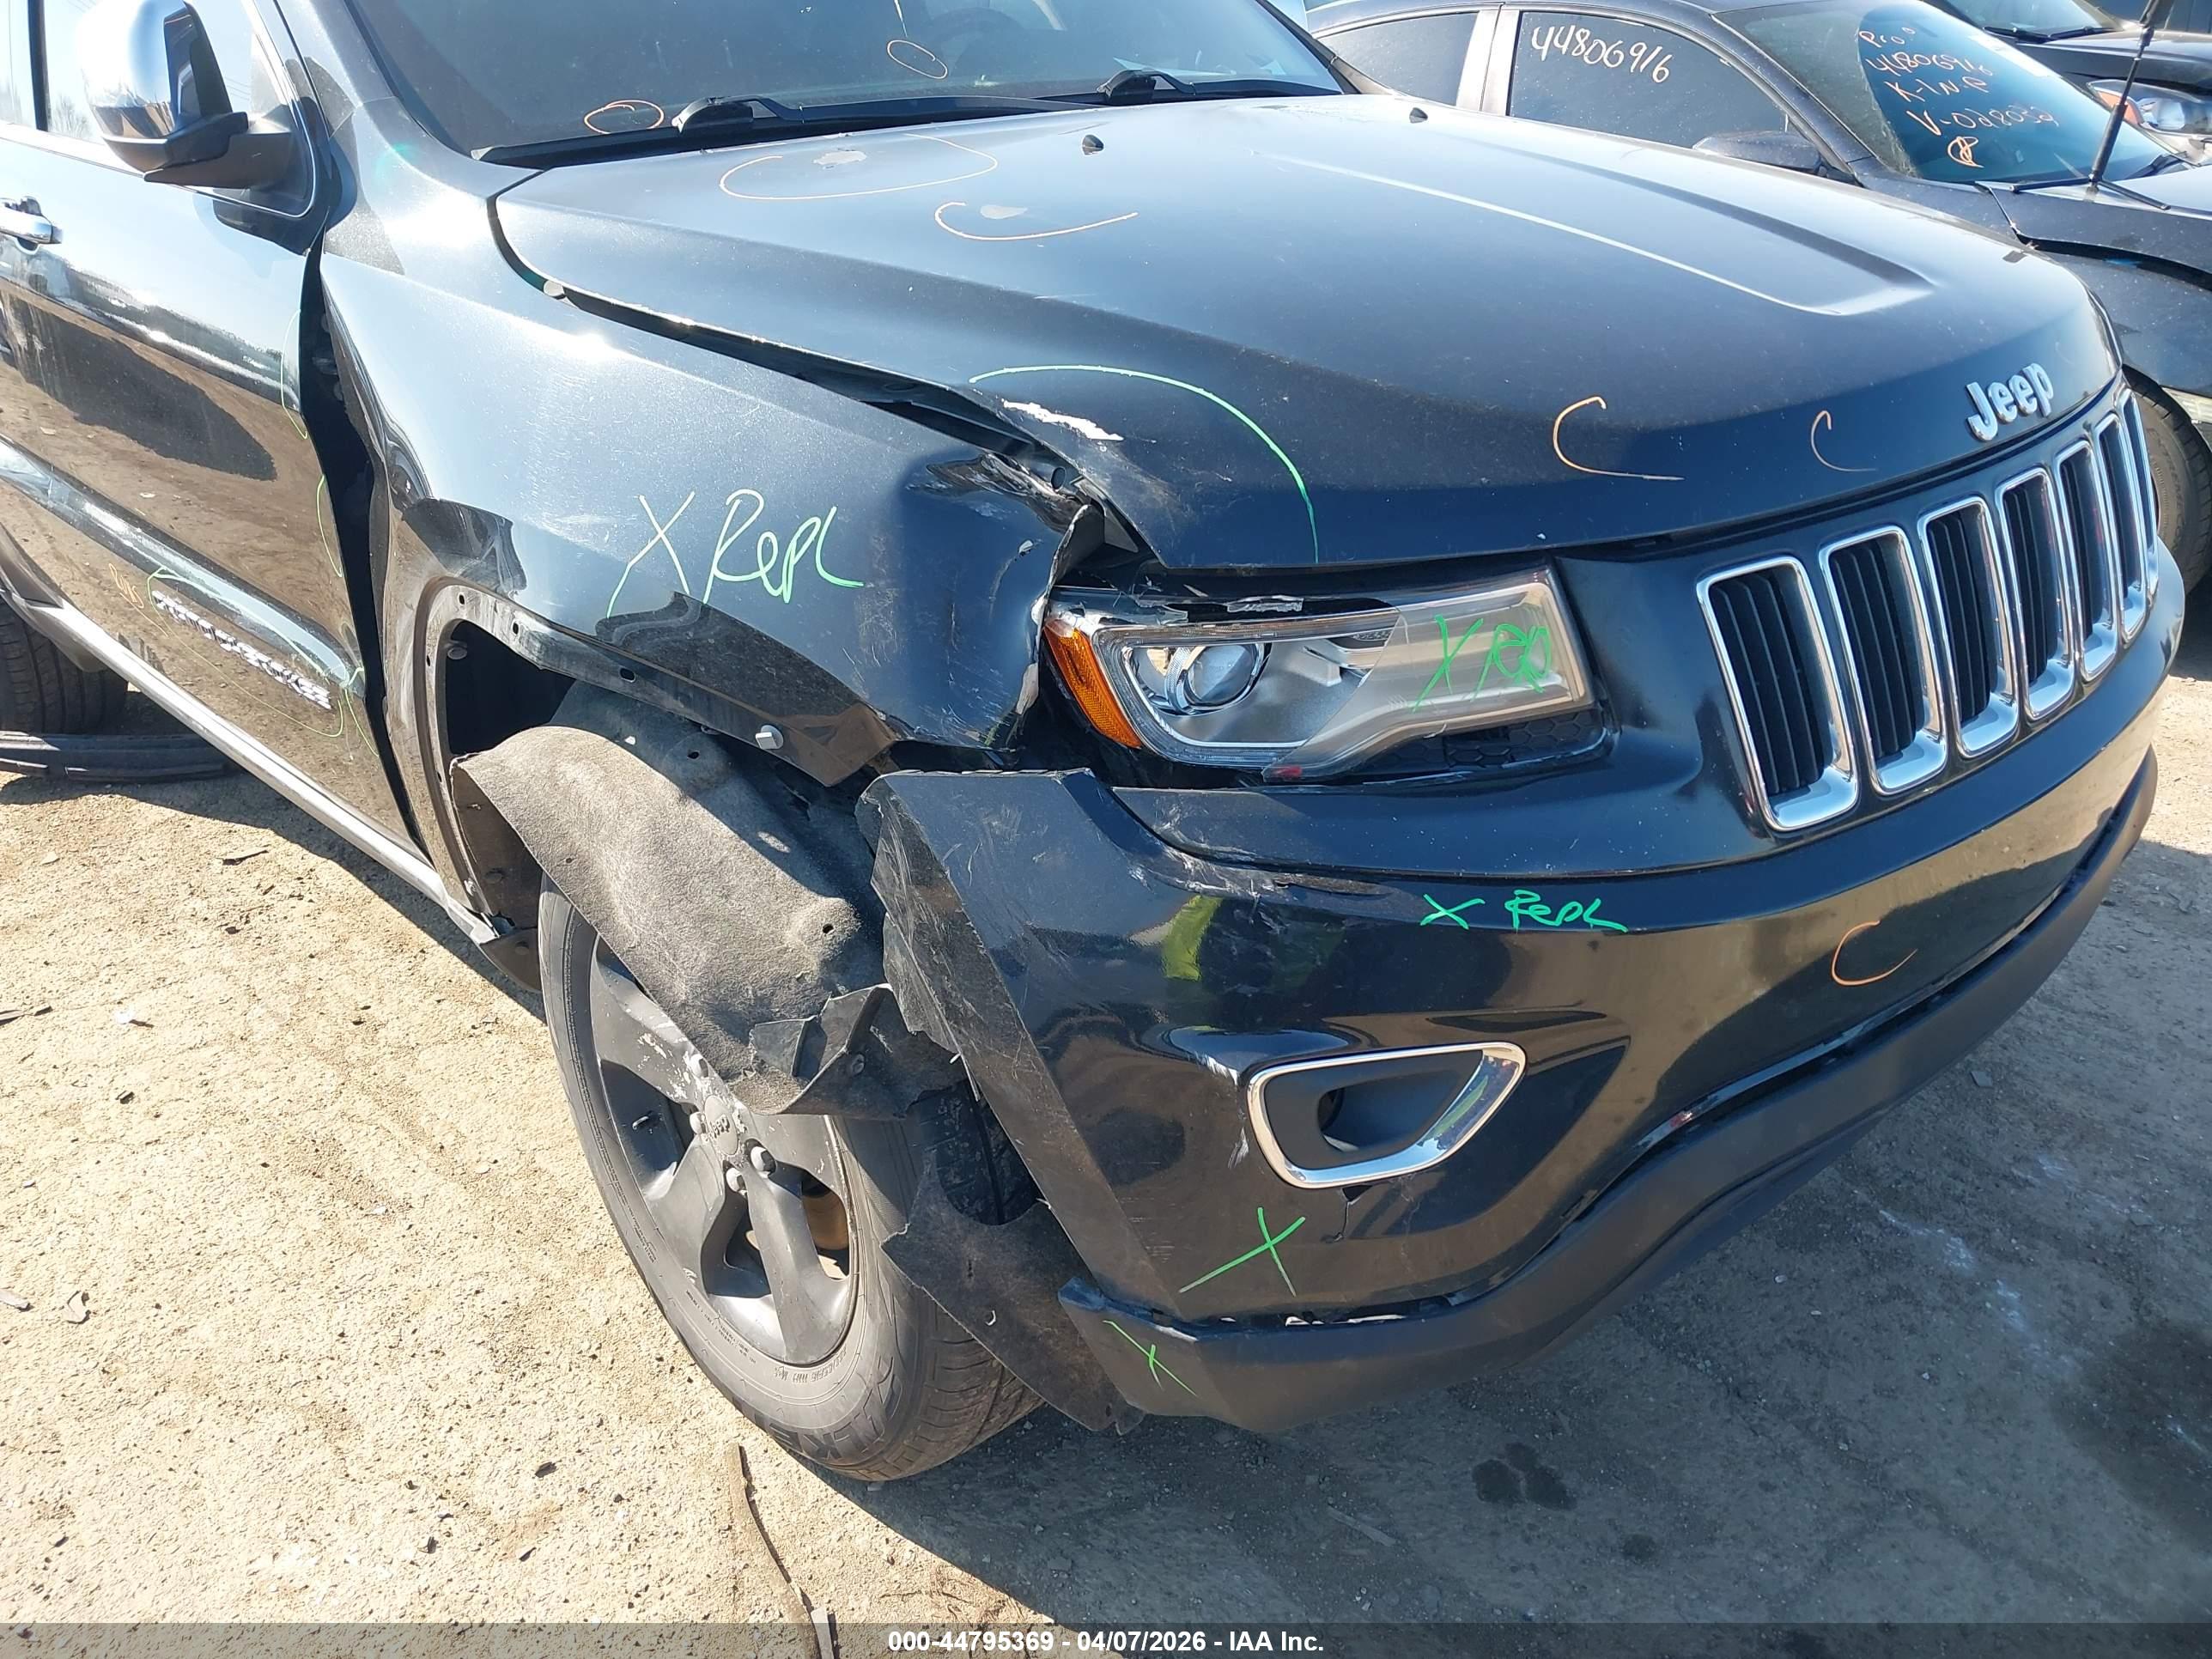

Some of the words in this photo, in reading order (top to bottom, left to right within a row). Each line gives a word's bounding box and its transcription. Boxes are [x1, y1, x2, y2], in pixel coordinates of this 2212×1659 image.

[1531, 25, 1673, 83] 44806916
[1966, 362, 2054, 441] Jeep
[606, 491, 696, 618] X
[1413, 614, 1485, 713] X
[1419, 893, 1486, 931] X
[1179, 1206, 1306, 1297] X
